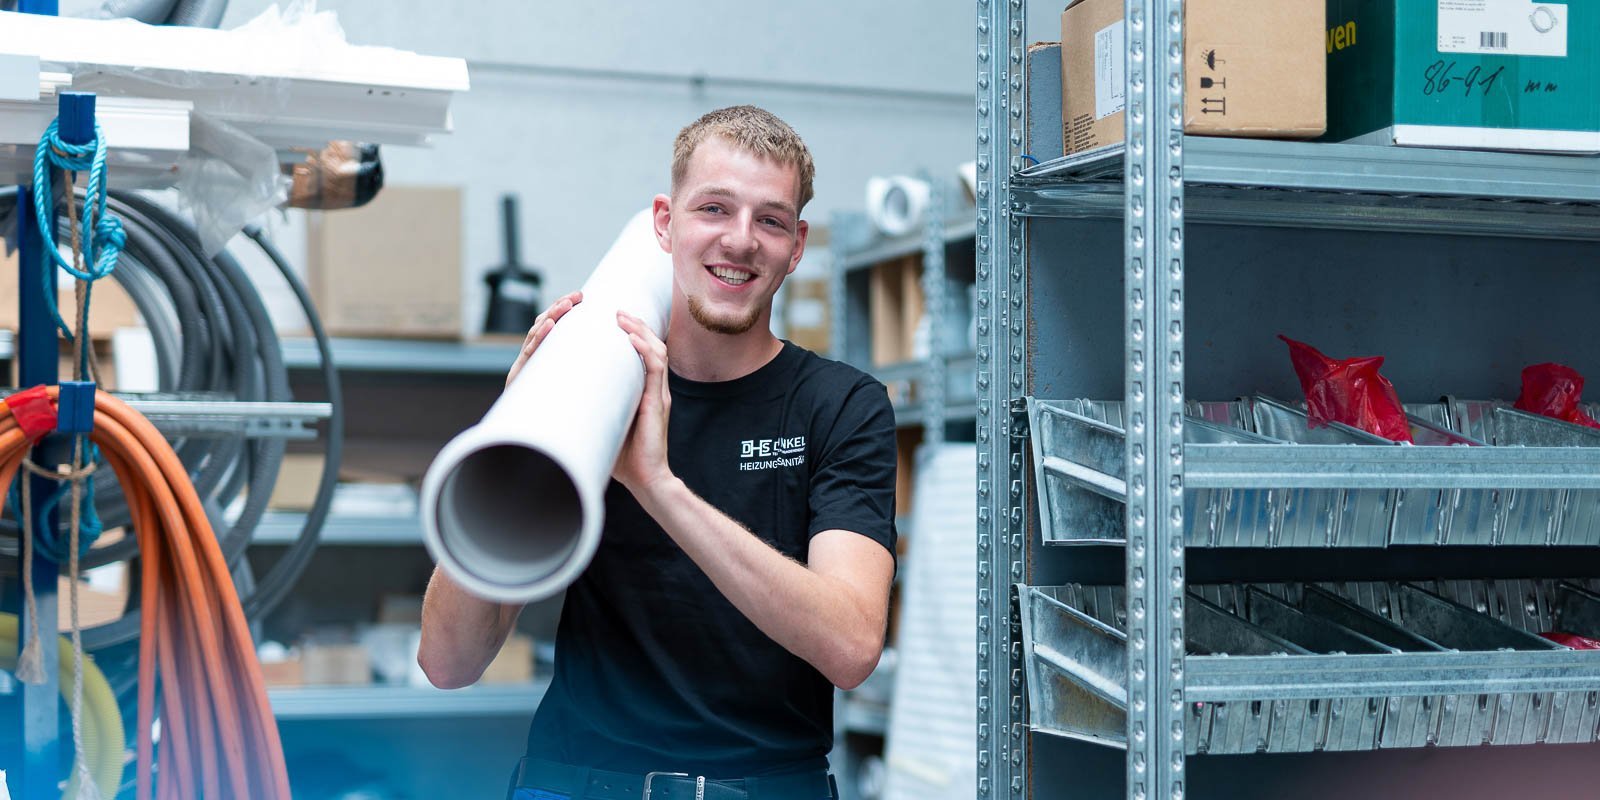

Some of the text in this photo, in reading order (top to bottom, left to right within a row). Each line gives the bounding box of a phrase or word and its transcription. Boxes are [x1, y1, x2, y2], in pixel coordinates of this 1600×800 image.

[740, 439, 772, 458] DHS
[740, 455, 805, 471] HEIZUNG SANITÄ
